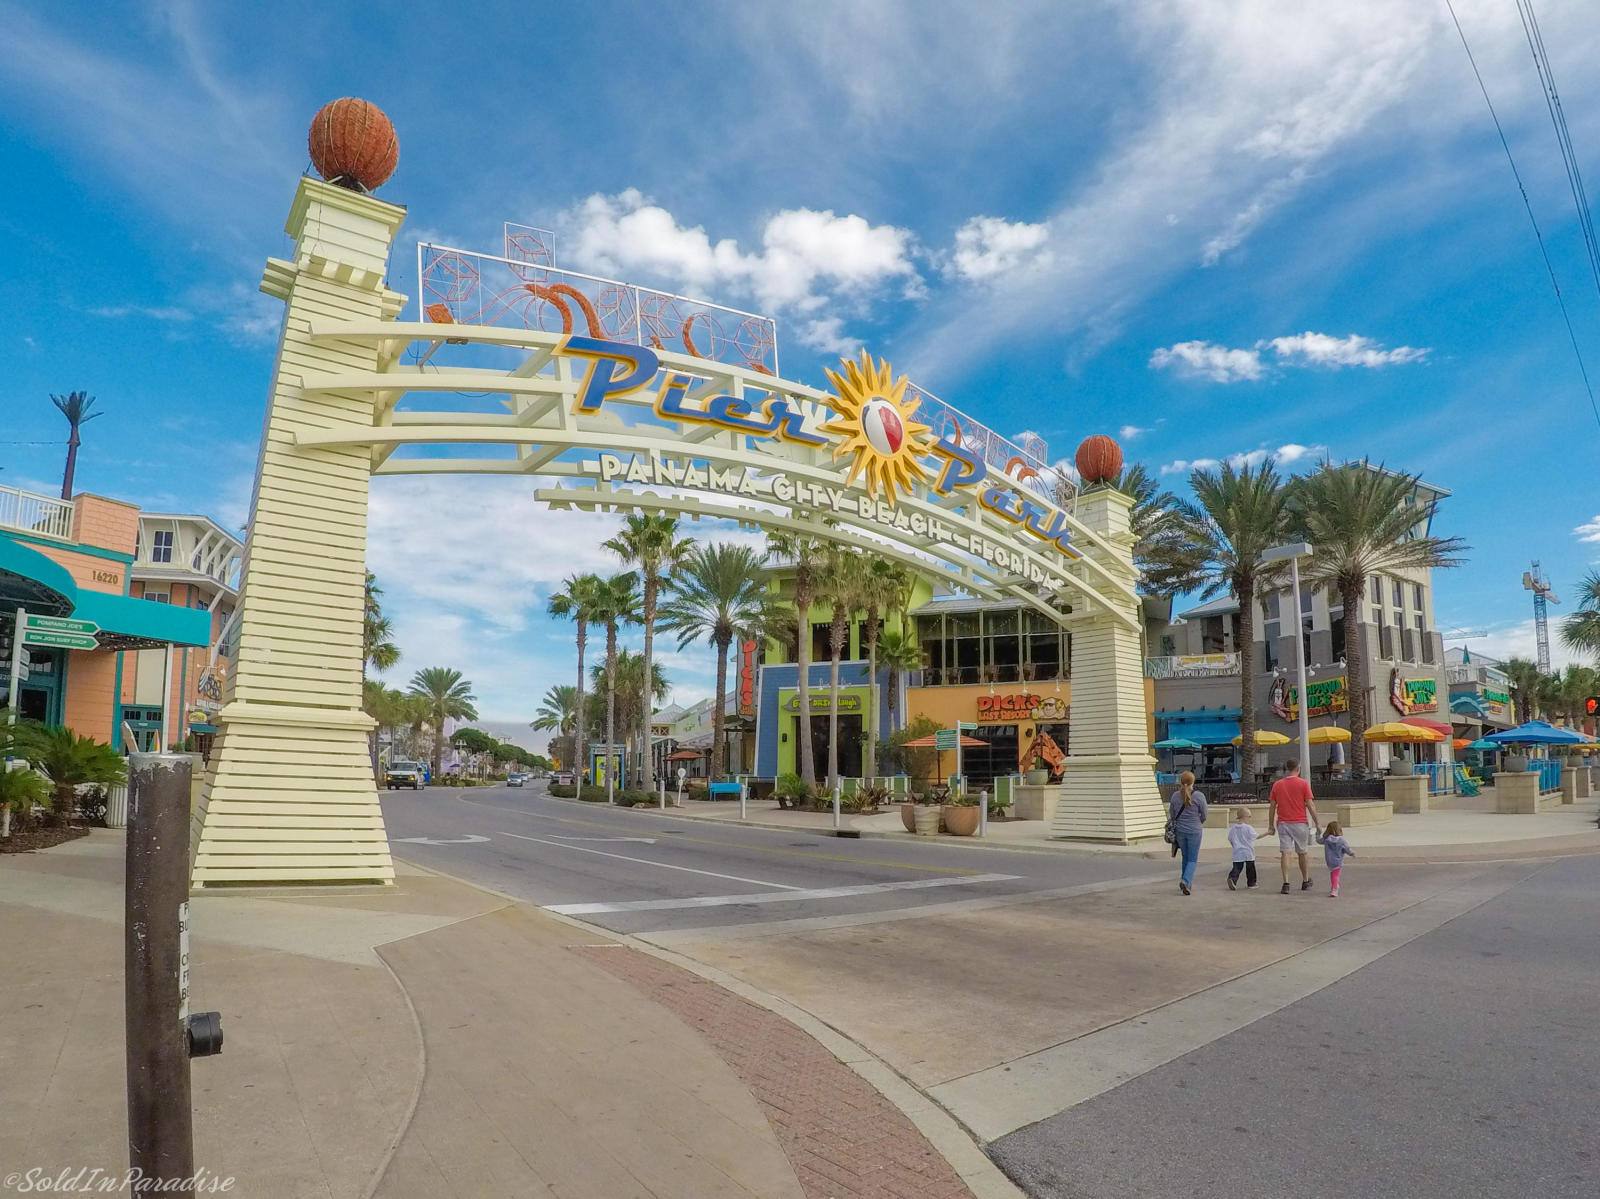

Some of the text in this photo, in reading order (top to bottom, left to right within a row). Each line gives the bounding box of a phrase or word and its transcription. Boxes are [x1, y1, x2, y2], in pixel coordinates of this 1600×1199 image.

[551, 334, 830, 450] Pier
[928, 436, 1084, 561] Park
[599, 452, 757, 496] PANAMA
[771, 475, 845, 513] CITY
[857, 495, 943, 542] BEACH
[968, 533, 1059, 590] FLORIDA
[92, 570, 119, 585] 16220
[977, 693, 1041, 711] DICK'S
[1290, 679, 1342, 706] PMPANO
[977, 709, 1031, 720] LAST RESORT
